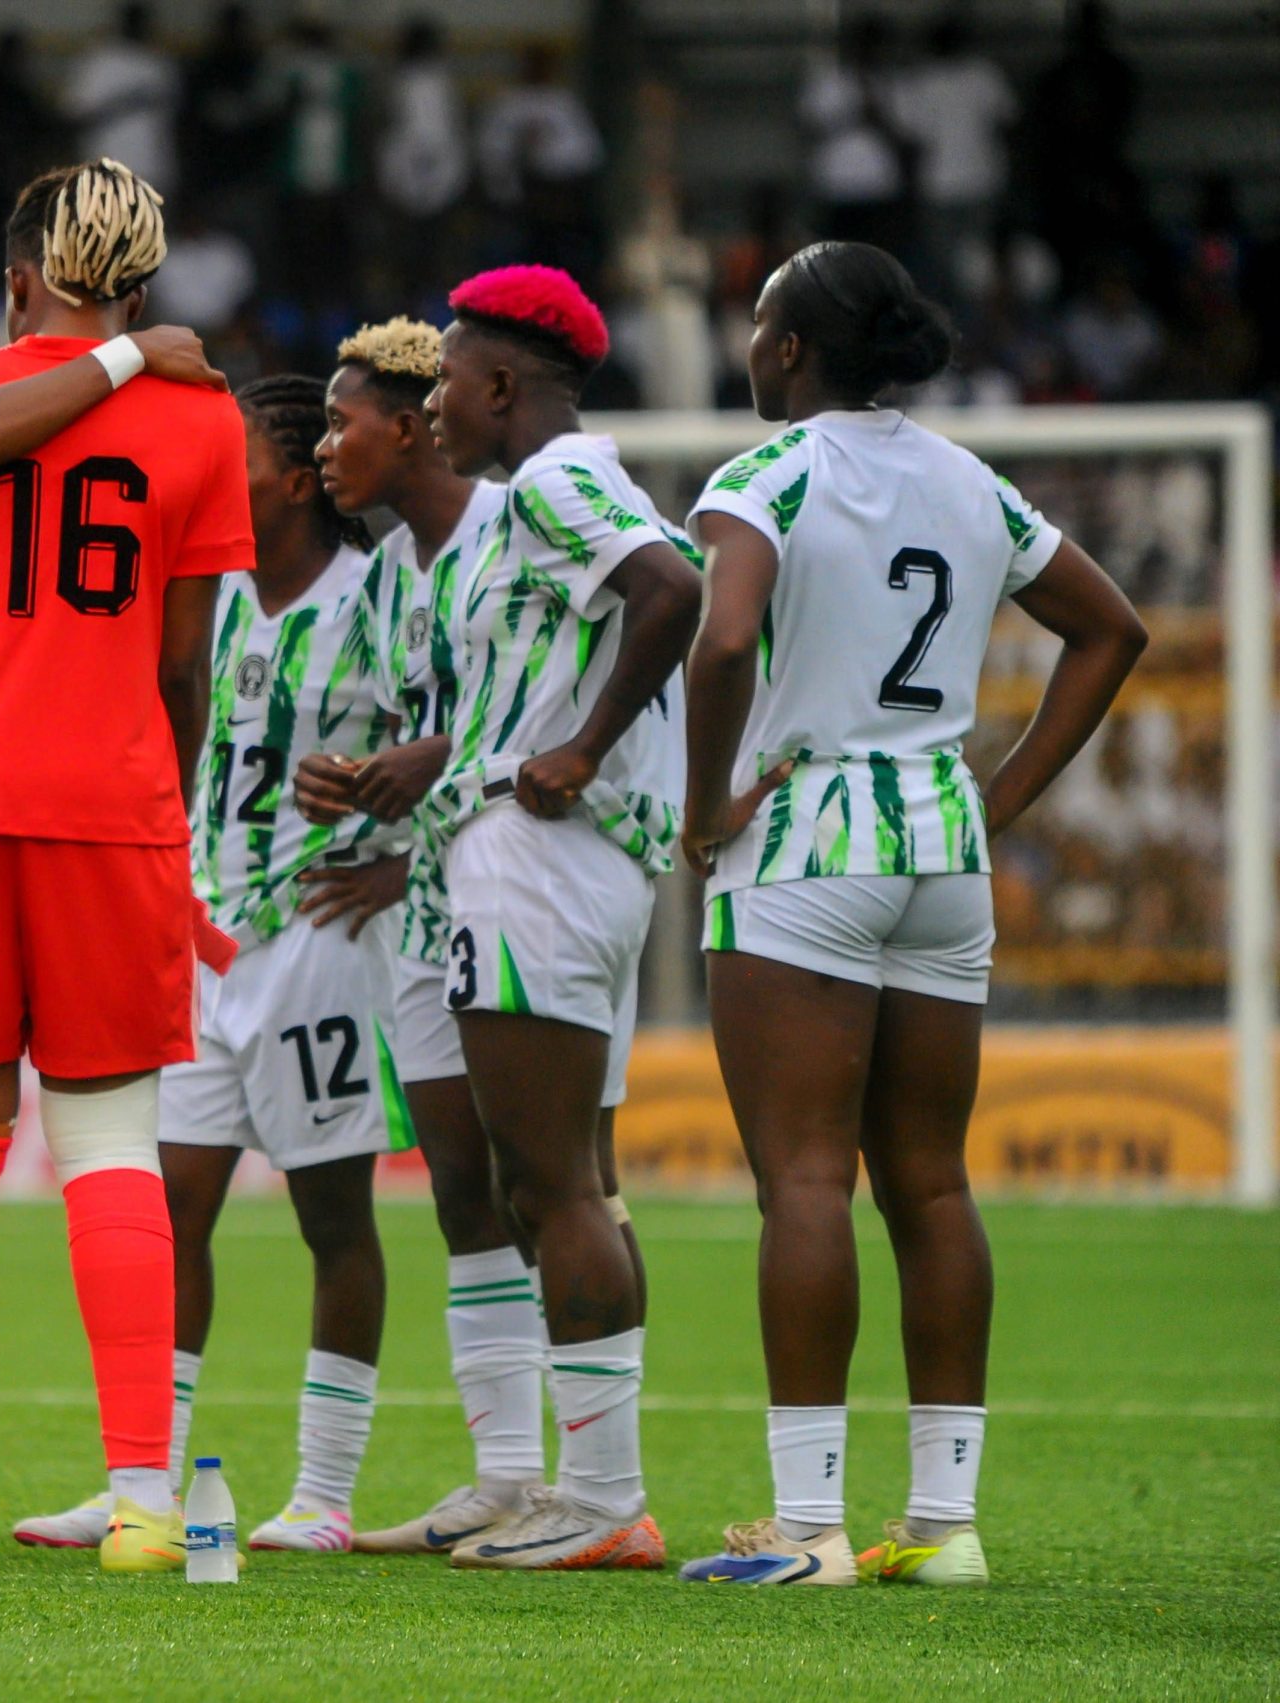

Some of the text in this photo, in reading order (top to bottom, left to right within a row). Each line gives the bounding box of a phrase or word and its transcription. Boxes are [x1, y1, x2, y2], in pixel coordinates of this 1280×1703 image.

[877, 546, 953, 713] 2
[215, 741, 284, 824] 12
[448, 926, 477, 1010] 3
[280, 1014, 370, 1103] 12
[825, 1452, 838, 1479] NFF
[955, 1439, 967, 1464] NFF
